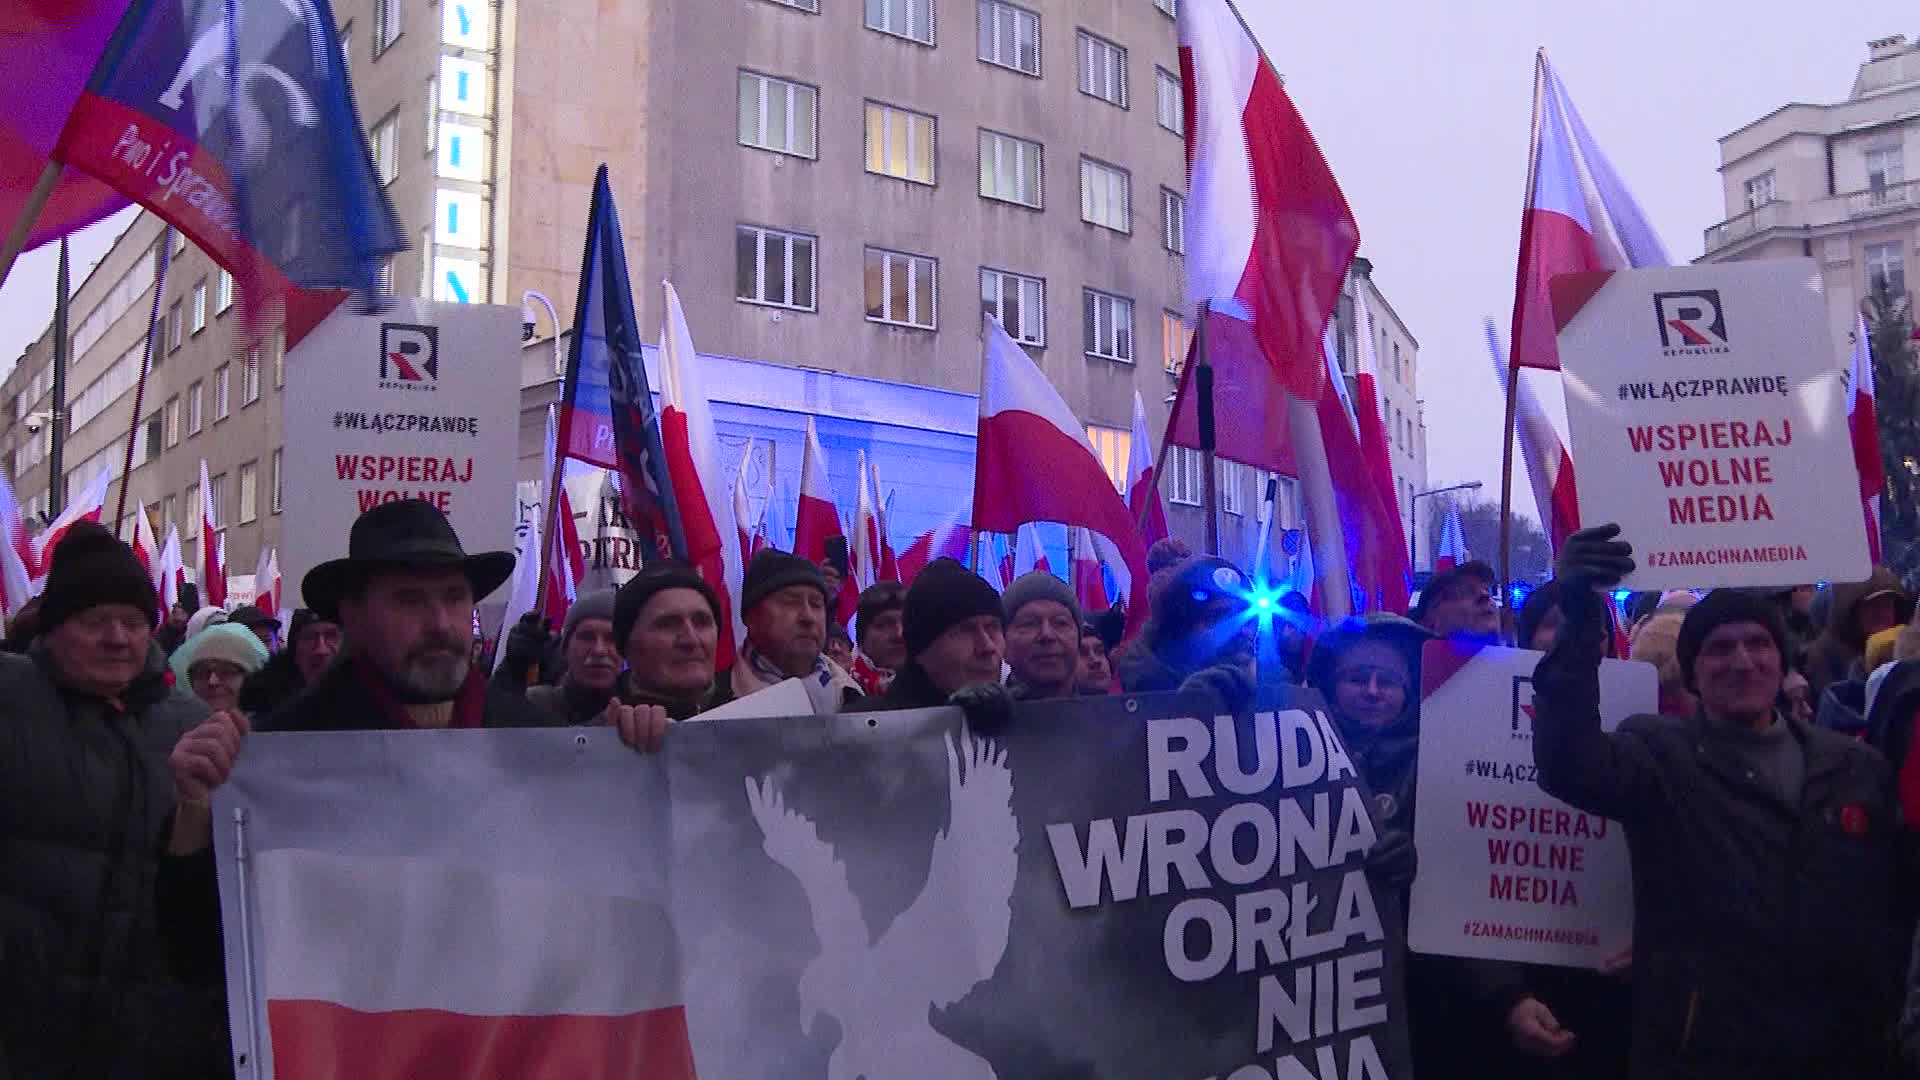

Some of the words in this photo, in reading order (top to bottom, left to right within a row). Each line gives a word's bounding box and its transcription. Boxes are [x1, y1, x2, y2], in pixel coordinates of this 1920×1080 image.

[1618, 376, 1789, 402] #WŁĄCZPRAWDĘ
[332, 411, 480, 437] #WŁĄCZPRAWDĘ
[1627, 419, 1792, 453] WSPIERAJ
[335, 454, 473, 483] WSPIERAJ
[1658, 457, 1773, 488] WOLNE
[1668, 494, 1775, 525] MEDIA
[1648, 545, 1808, 569] #ZAMACHNAMEDIA
[1146, 708, 1359, 803] RUDA
[1464, 759, 1538, 784] #WŁĄCZ
[1466, 801, 1608, 840] WSPIERAJ
[1046, 786, 1378, 909] WRONA
[1487, 838, 1585, 872] WOLNE
[1489, 873, 1579, 907] MEDIA
[1163, 869, 1385, 983] ORŁA
[1463, 920, 1600, 946] #ZAMACHNAMEDIA
[1257, 949, 1389, 1055] NIE
